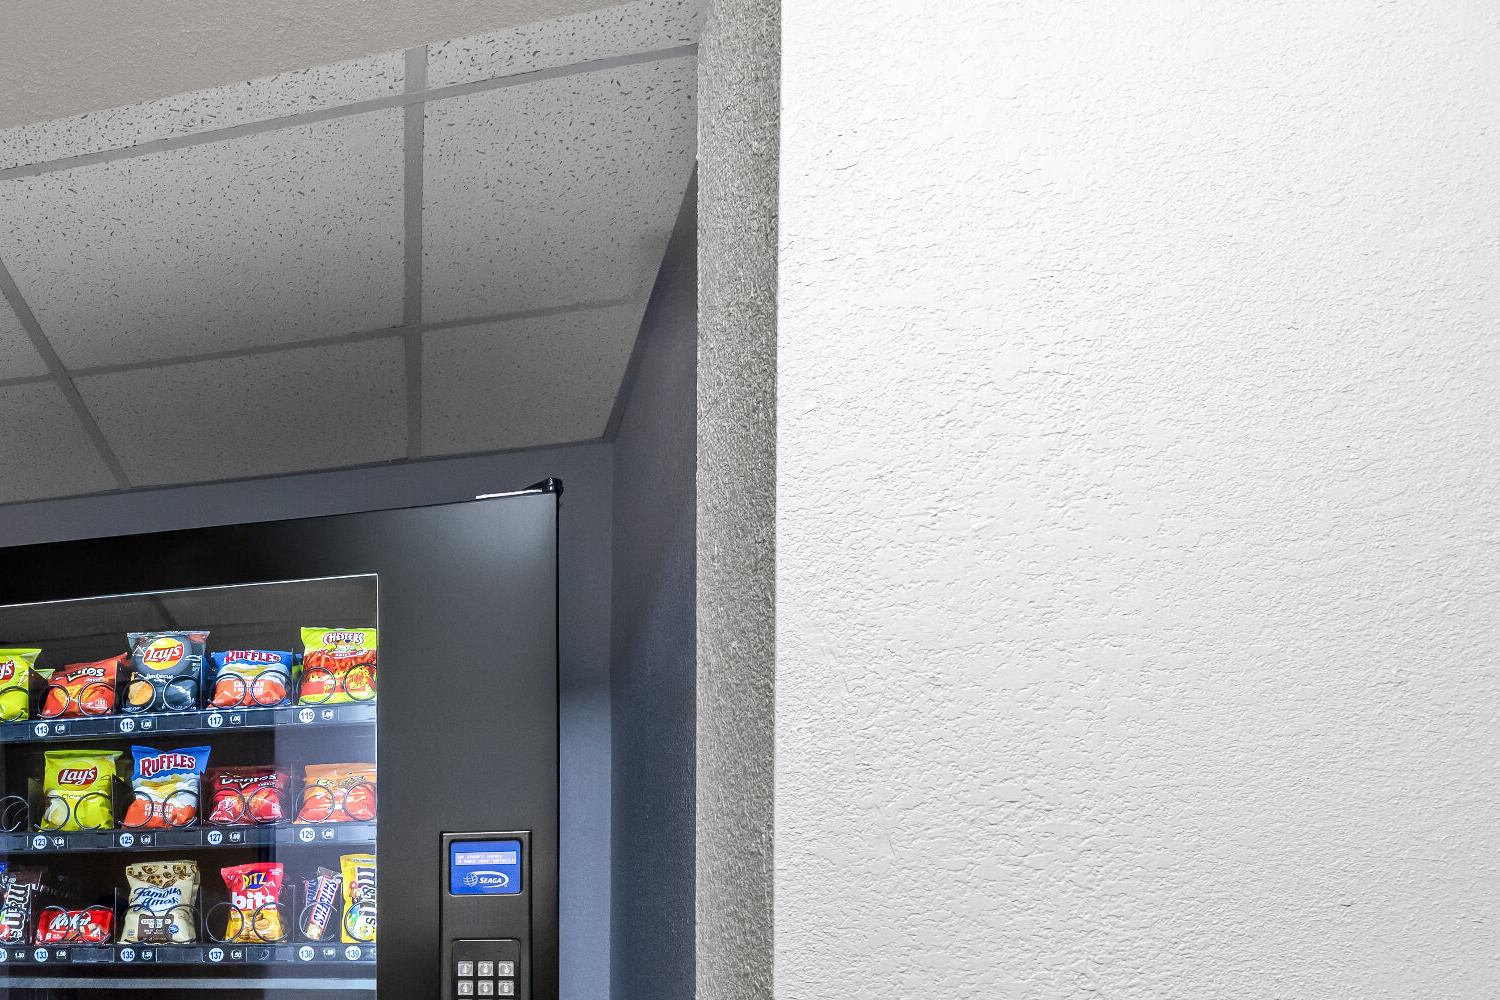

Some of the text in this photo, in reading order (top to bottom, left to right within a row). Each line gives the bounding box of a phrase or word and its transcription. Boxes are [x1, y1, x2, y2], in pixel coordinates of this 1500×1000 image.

[143, 645, 183, 663] Lay's
[226, 650, 282, 663] RUFFLES
[140, 753, 196, 777] RUFFLES
[59, 766, 97, 786] Lay's
[241, 871, 268, 891] RITZ
[132, 885, 183, 902] Famous
[231, 892, 277, 910] bits
